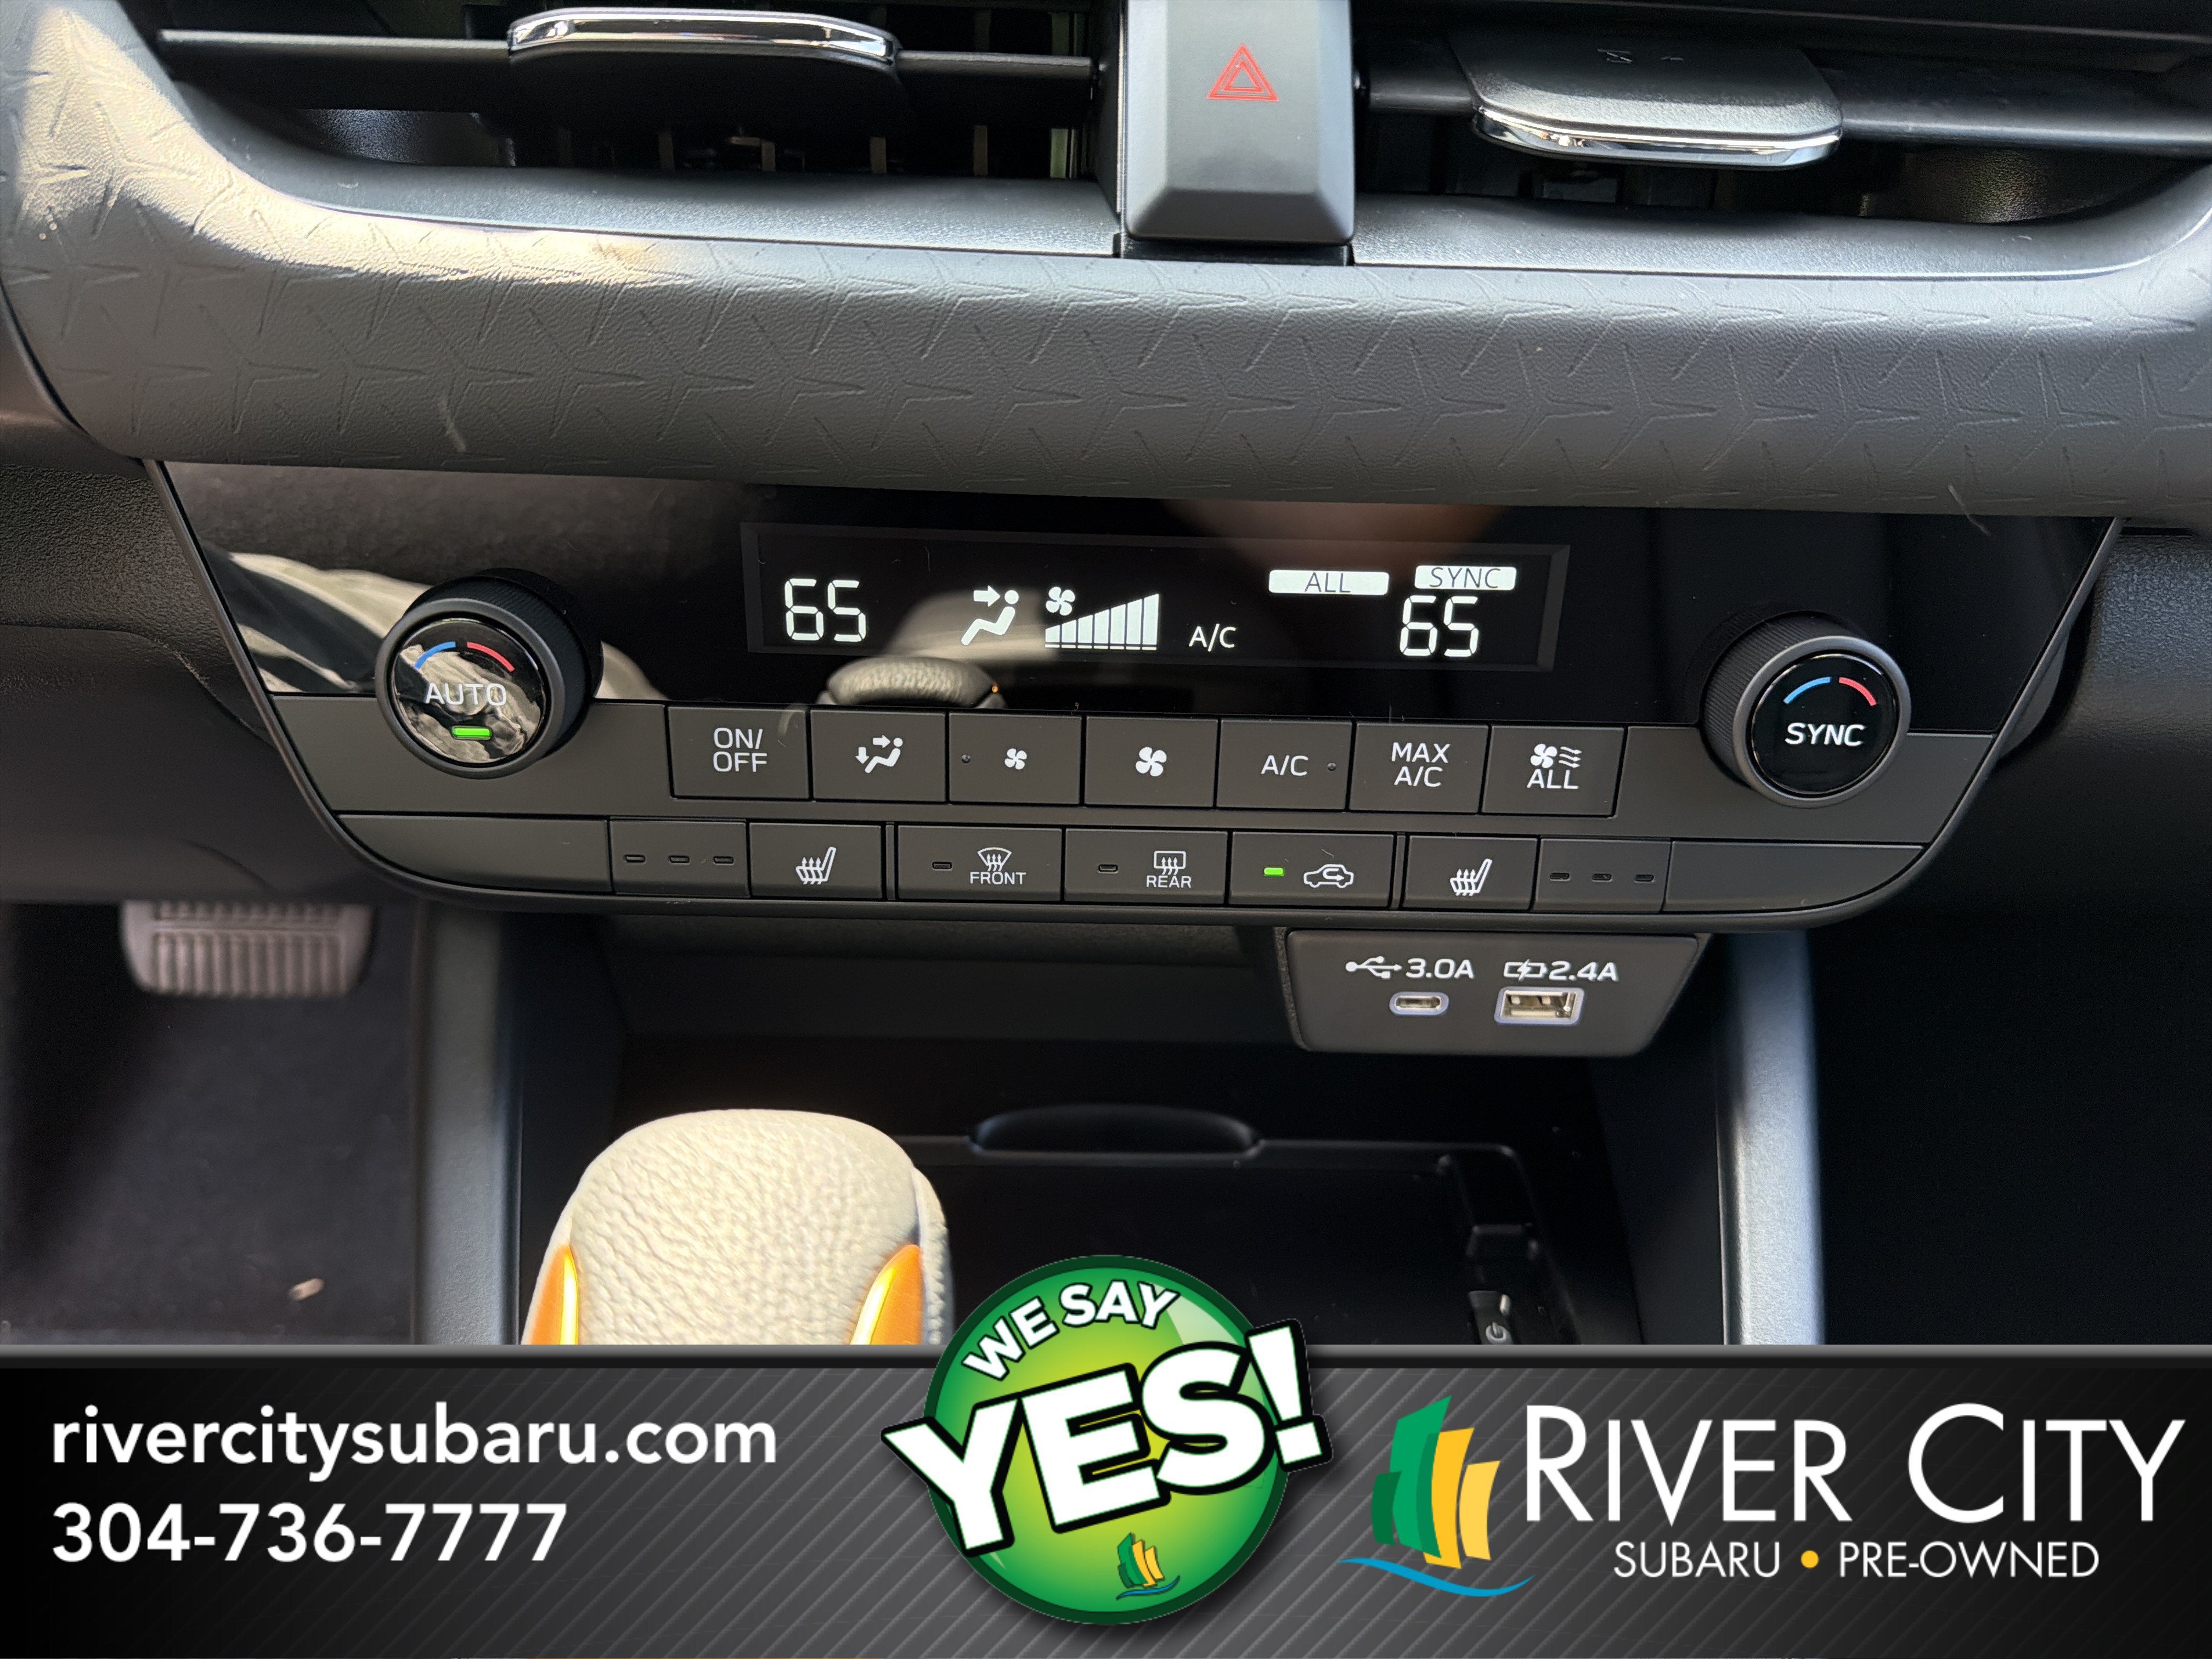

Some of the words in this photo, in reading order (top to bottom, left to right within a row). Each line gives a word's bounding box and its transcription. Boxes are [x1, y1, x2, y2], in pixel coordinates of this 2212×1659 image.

[1304, 572, 1352, 593] ALL
[1429, 566, 1502, 589] SYNC
[784, 578, 866, 642] 65
[1400, 595, 1479, 657] 65
[1188, 623, 1237, 652] A/C
[425, 682, 507, 707] AUTO
[713, 727, 763, 749] ON/
[1784, 723, 1865, 747] SYNC
[713, 751, 768, 772] OFF
[1391, 742, 1451, 764] MAX
[1261, 755, 1309, 776] A/C
[1393, 766, 1443, 787] A/C
[1526, 769, 1579, 789] ALL
[969, 871, 1026, 885] FRONT
[1146, 874, 1192, 889] REAR
[1405, 958, 1475, 979] 3.0A
[1548, 961, 1618, 982] 2.4A
